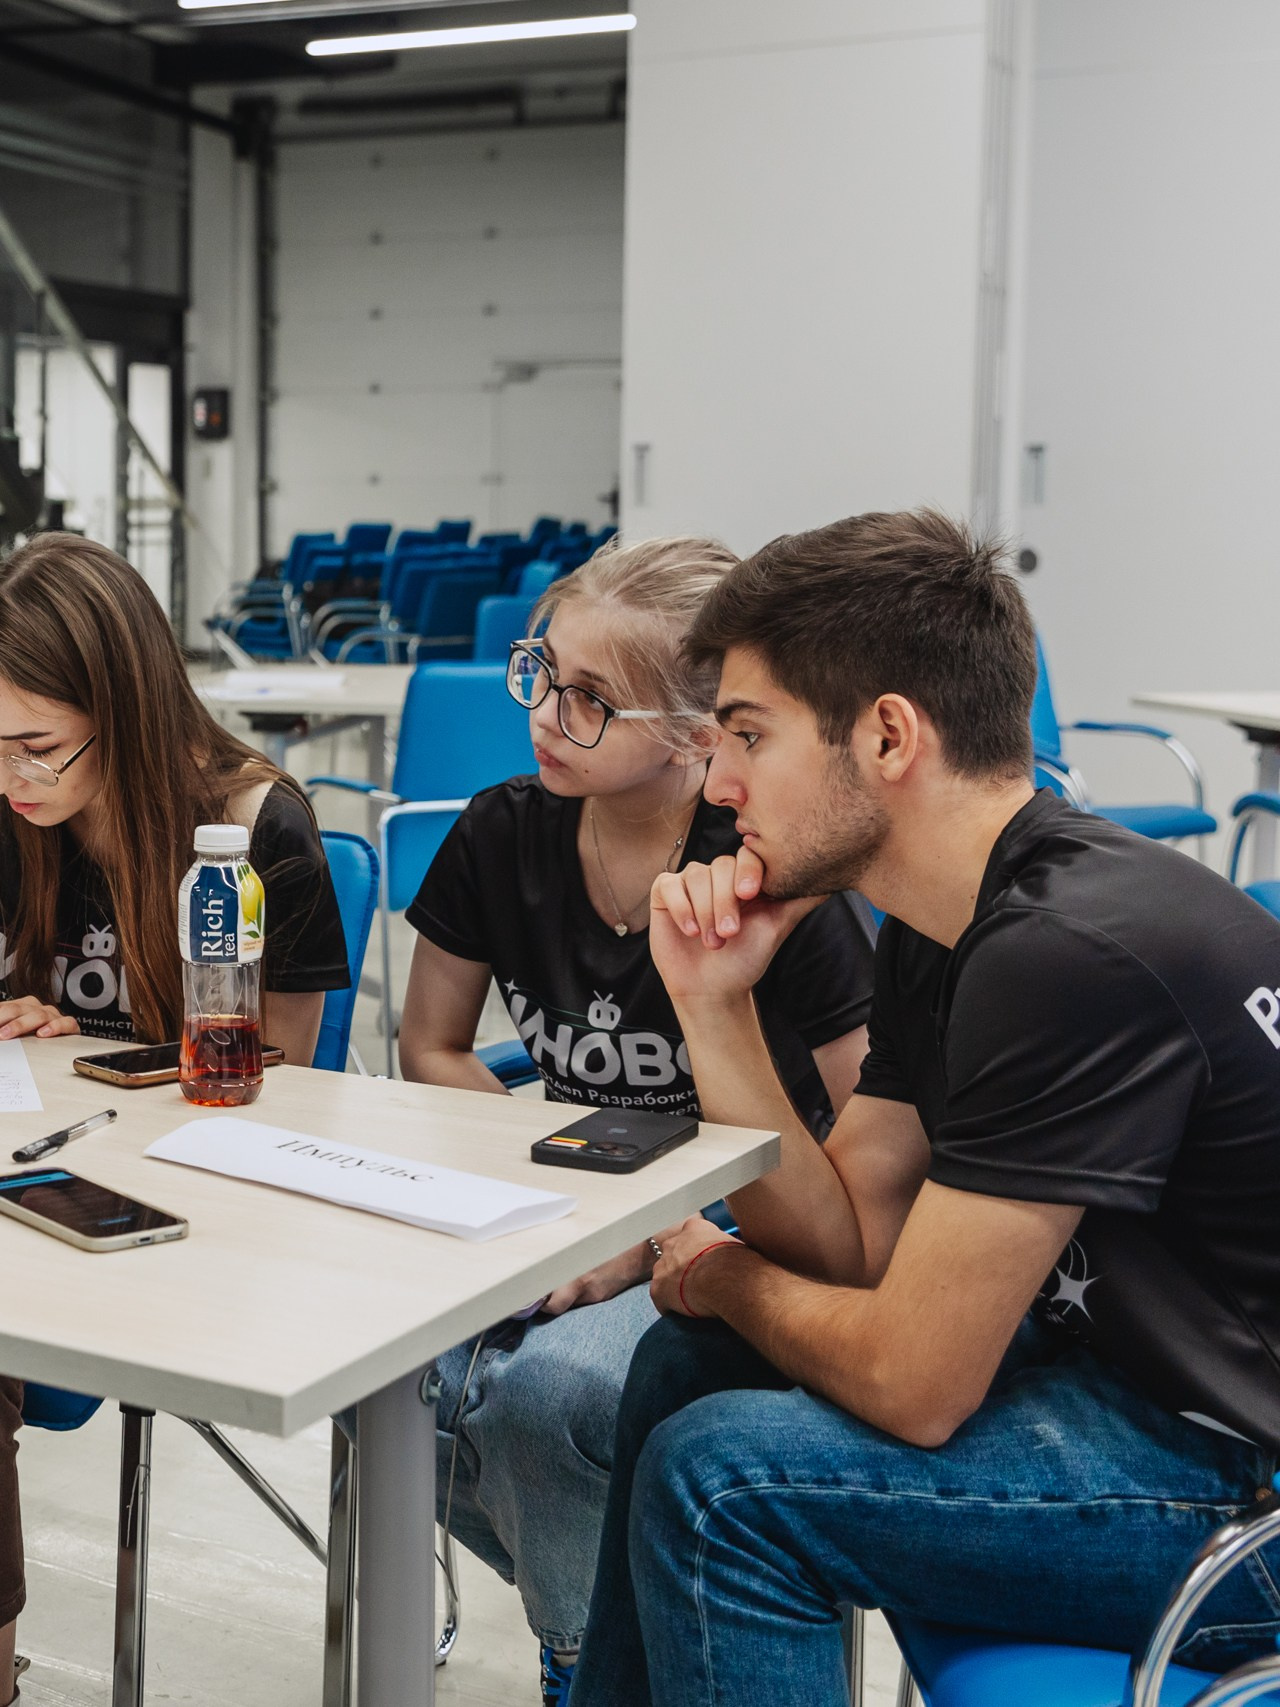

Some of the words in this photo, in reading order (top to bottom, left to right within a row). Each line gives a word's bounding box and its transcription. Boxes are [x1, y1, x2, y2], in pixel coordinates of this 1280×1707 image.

[201, 899, 224, 957] Rich
[224, 933, 236, 957] tea
[537, 1066, 583, 1098] Отдел
[275, 1139, 434, 1183] Импульс
